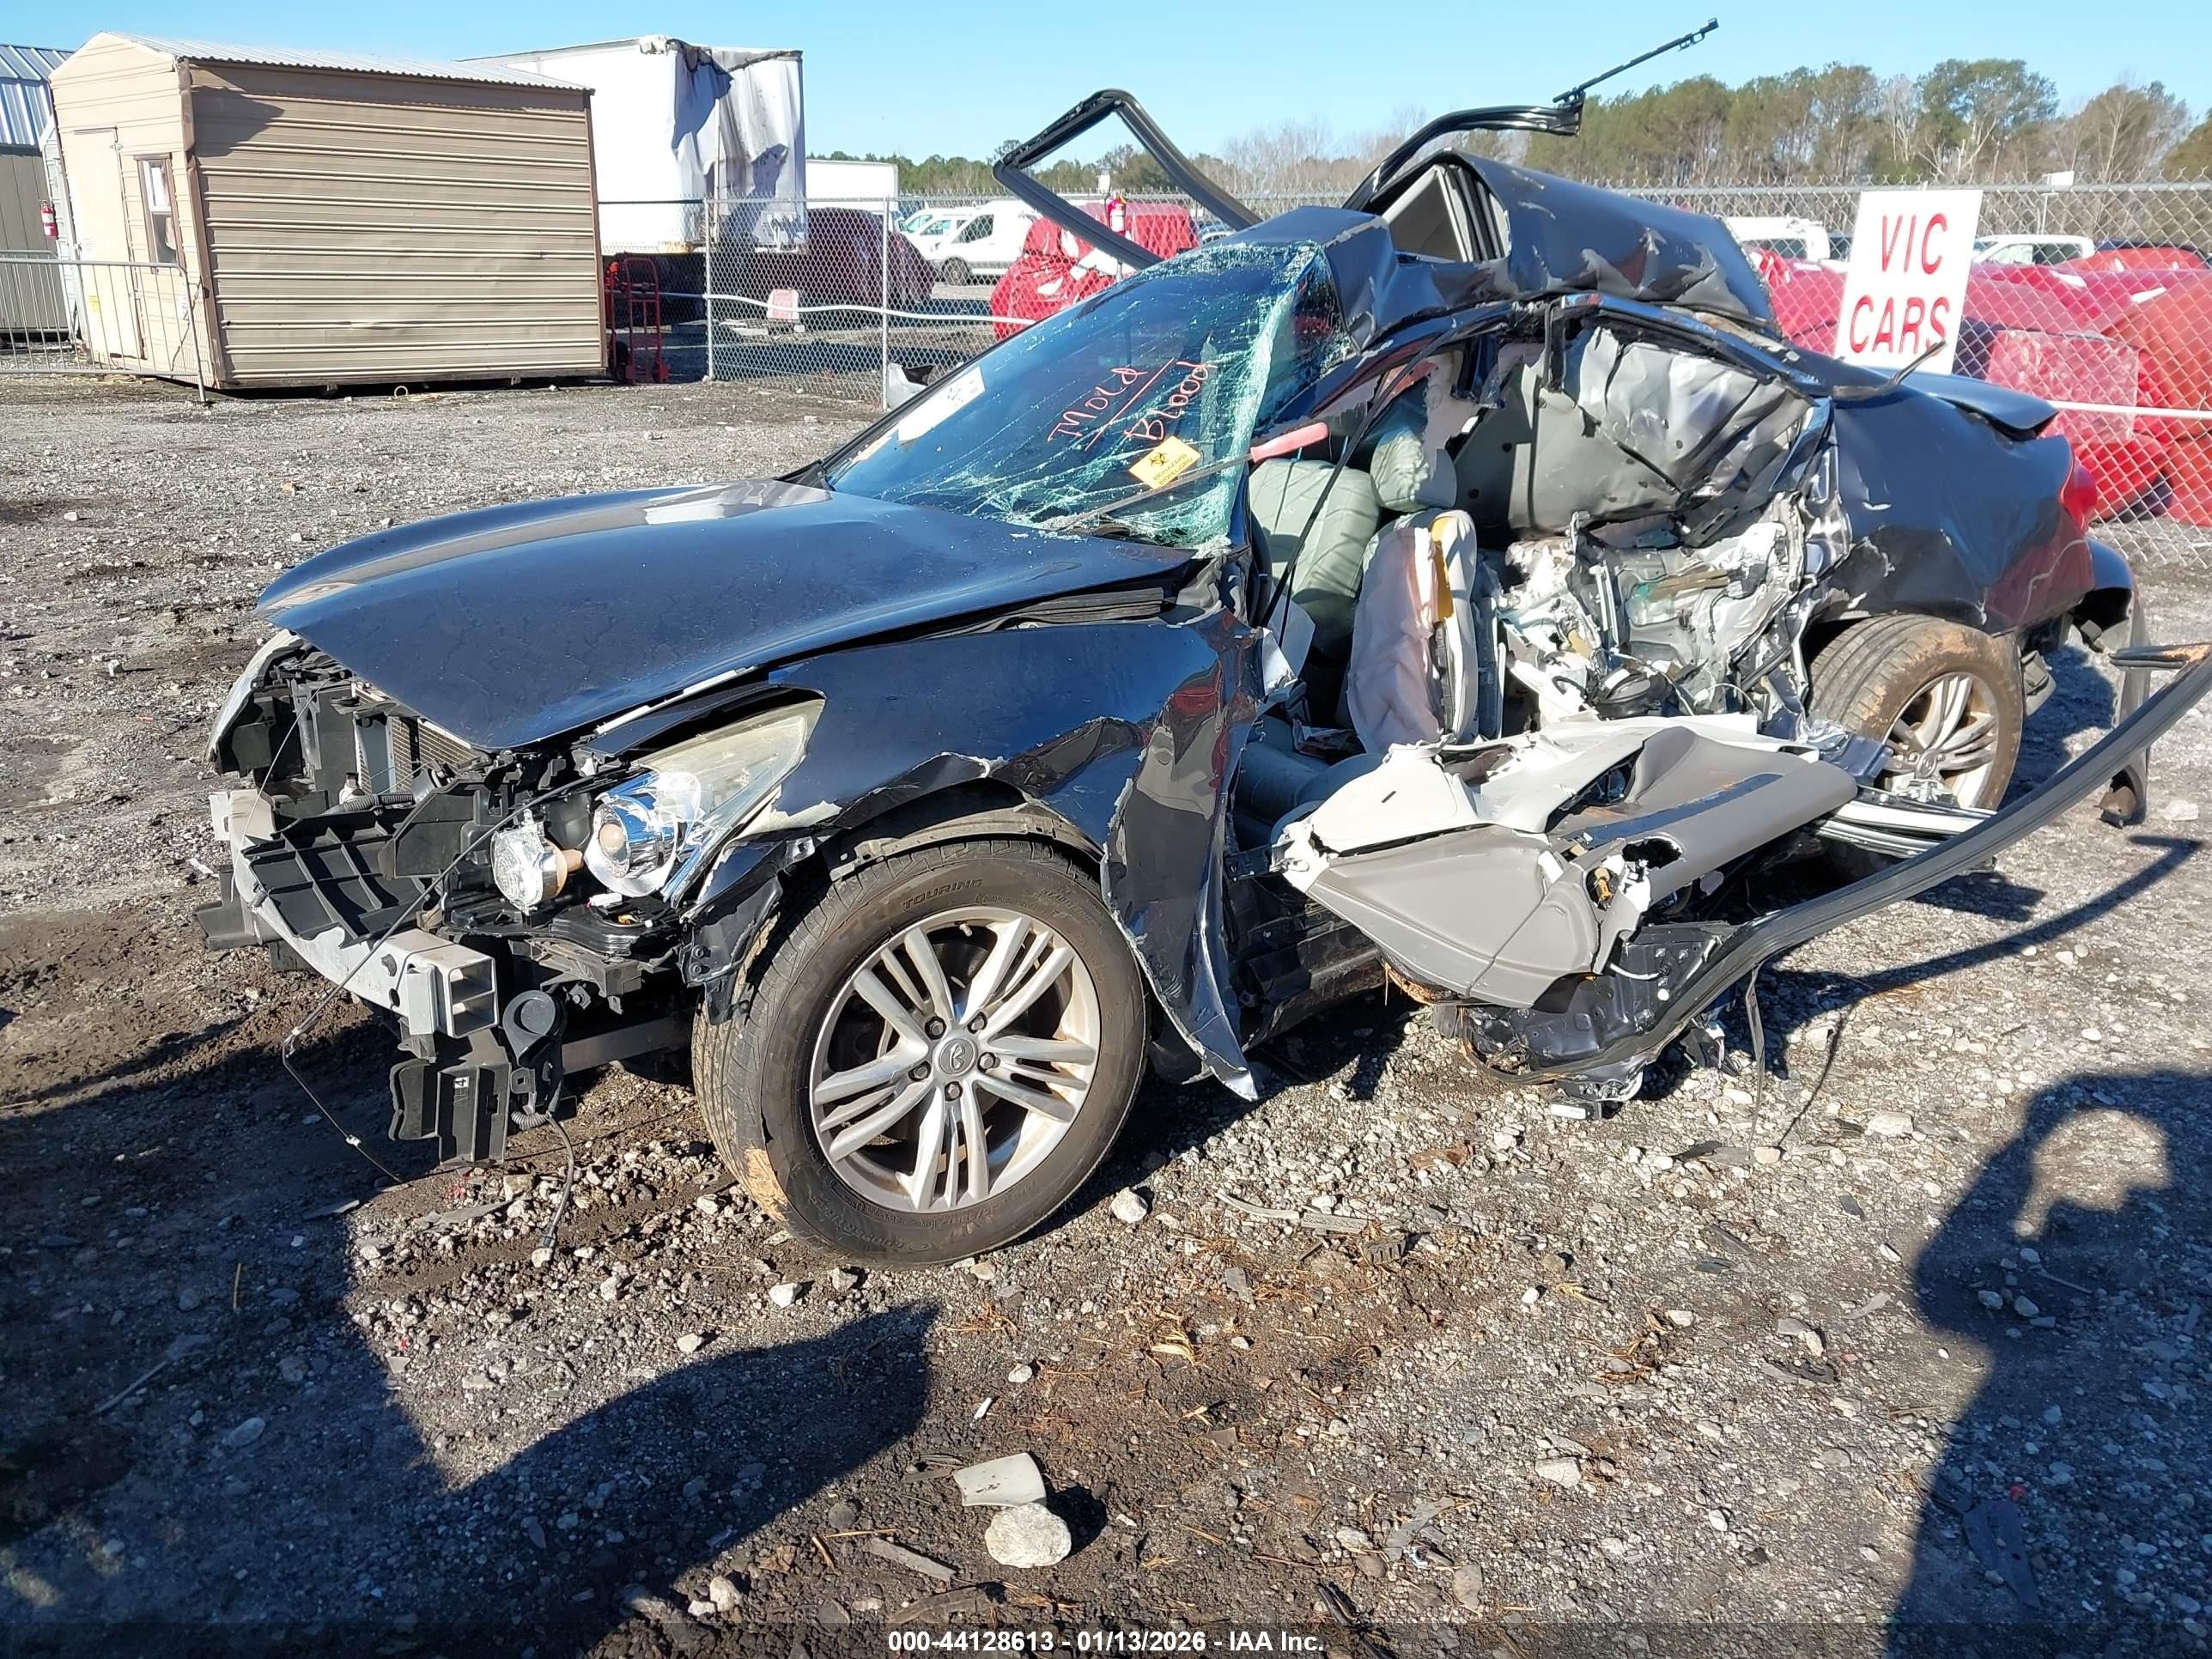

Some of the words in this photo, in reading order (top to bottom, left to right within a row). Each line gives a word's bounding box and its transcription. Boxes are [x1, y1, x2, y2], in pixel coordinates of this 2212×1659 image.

[1881, 213, 1948, 276] VIC
[1849, 295, 1951, 357] CARS
[902, 878, 983, 911] TOURING
